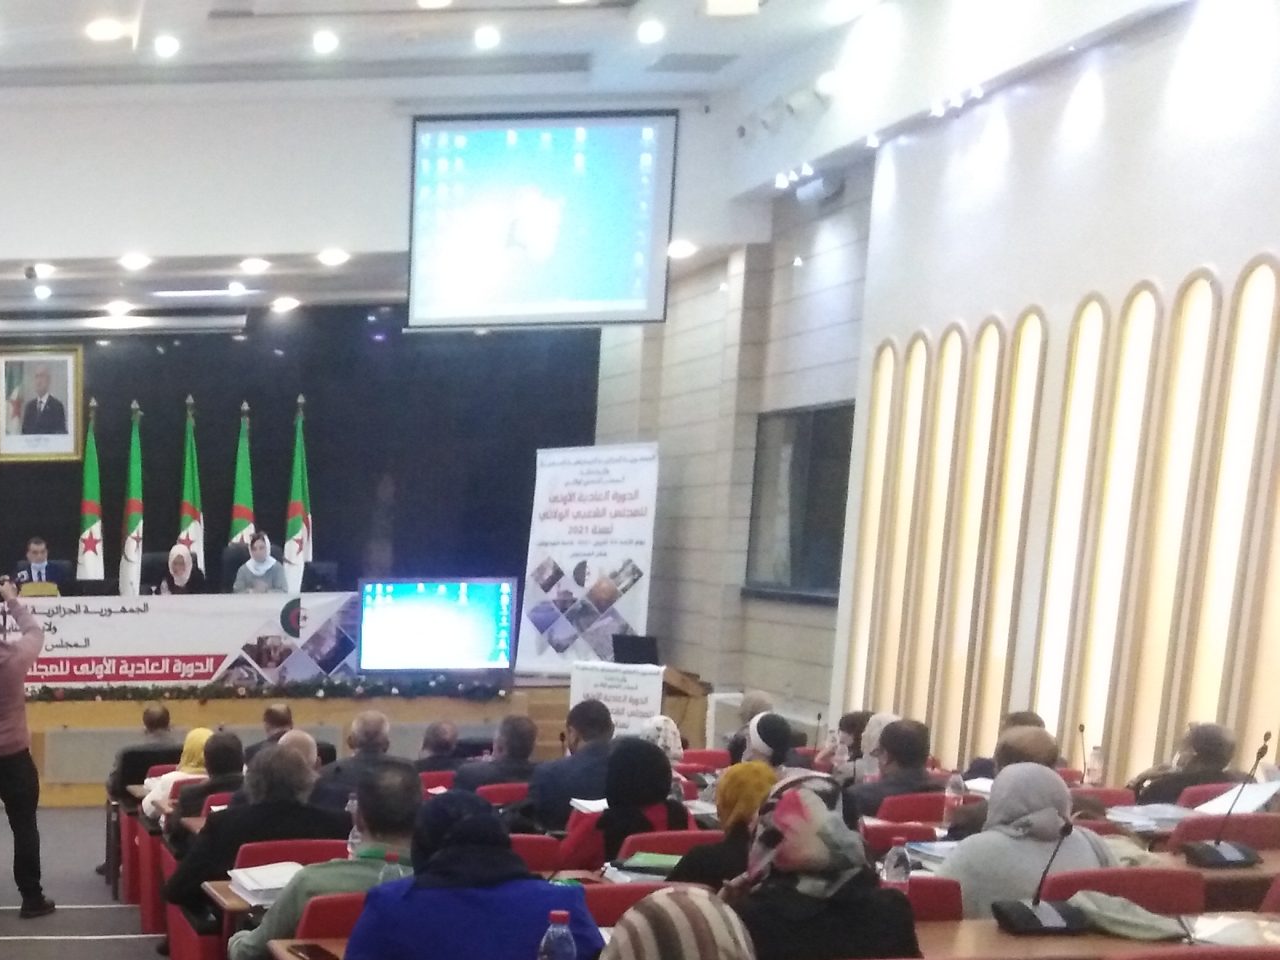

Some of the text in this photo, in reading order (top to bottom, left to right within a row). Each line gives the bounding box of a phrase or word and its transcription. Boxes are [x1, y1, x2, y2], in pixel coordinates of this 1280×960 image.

[30, 603, 81, 618] الجزائرية
[83, 602, 149, 617] الجمهورية
[45, 637, 90, 652] المجلس
[26, 656, 215, 680] الدورة العادية الأولى للمجل
